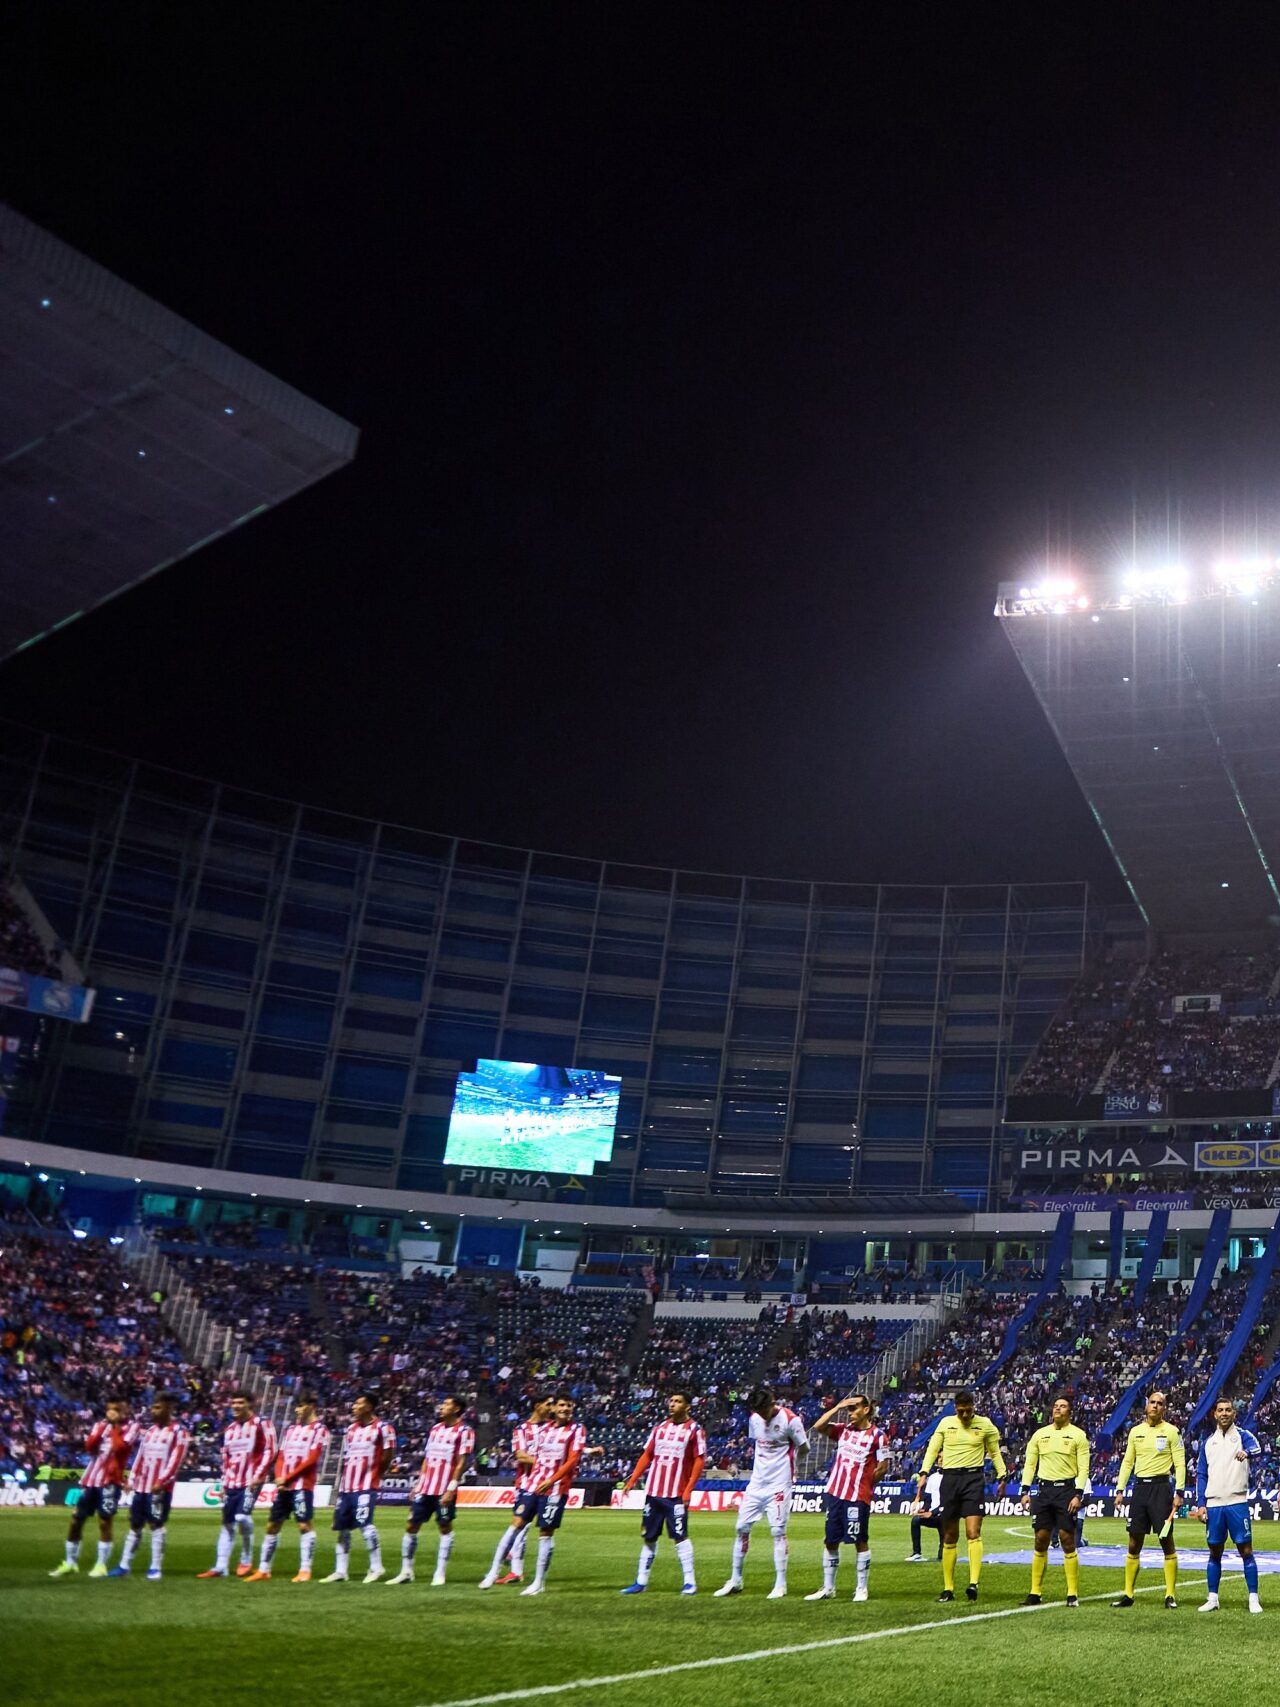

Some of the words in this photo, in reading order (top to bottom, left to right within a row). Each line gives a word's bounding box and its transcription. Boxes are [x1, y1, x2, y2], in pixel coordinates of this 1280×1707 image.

[1021, 1148, 1141, 1169] PIRMA
[1203, 1149, 1251, 1161] IKEA
[460, 1168, 551, 1188] PIRMA
[543, 1505, 559, 1519] 37
[675, 1517, 683, 1530] 5
[848, 1522, 860, 1535] 28
